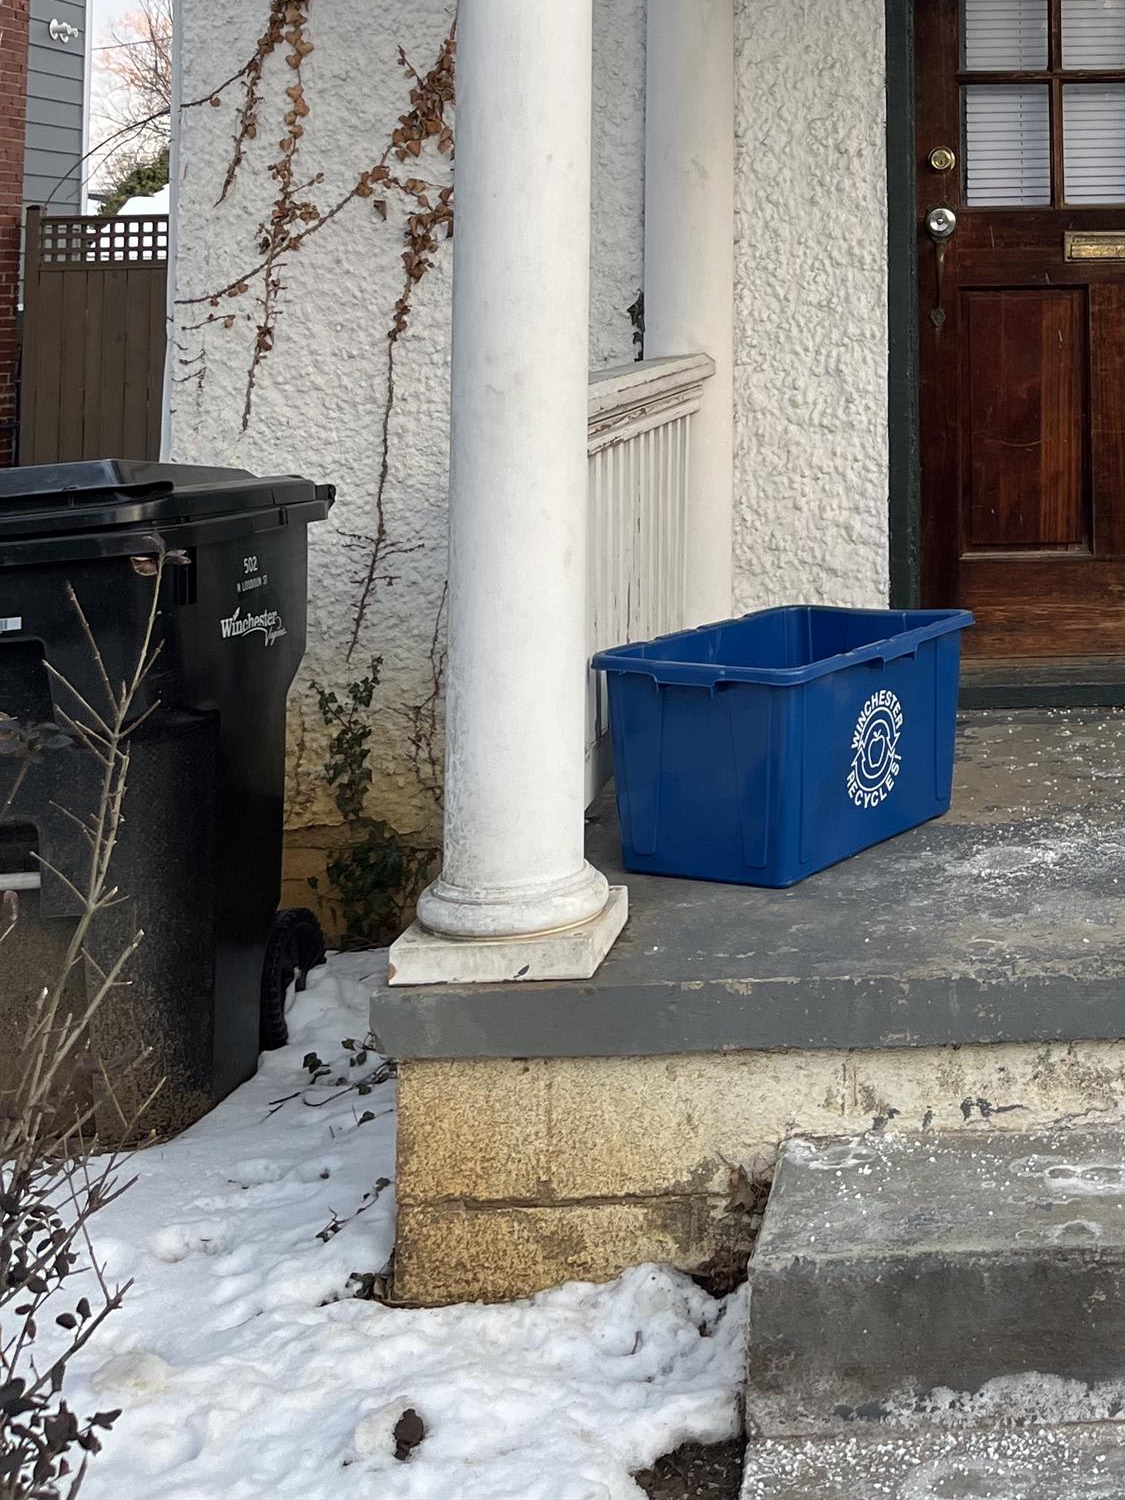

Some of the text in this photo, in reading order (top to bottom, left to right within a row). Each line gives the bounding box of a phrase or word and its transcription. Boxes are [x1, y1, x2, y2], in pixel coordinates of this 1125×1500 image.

[244, 556, 258, 574] 502
[220, 607, 278, 638] Winchester
[850, 689, 903, 749] WINCHESTER
[846, 754, 902, 809] RECYCLES!
